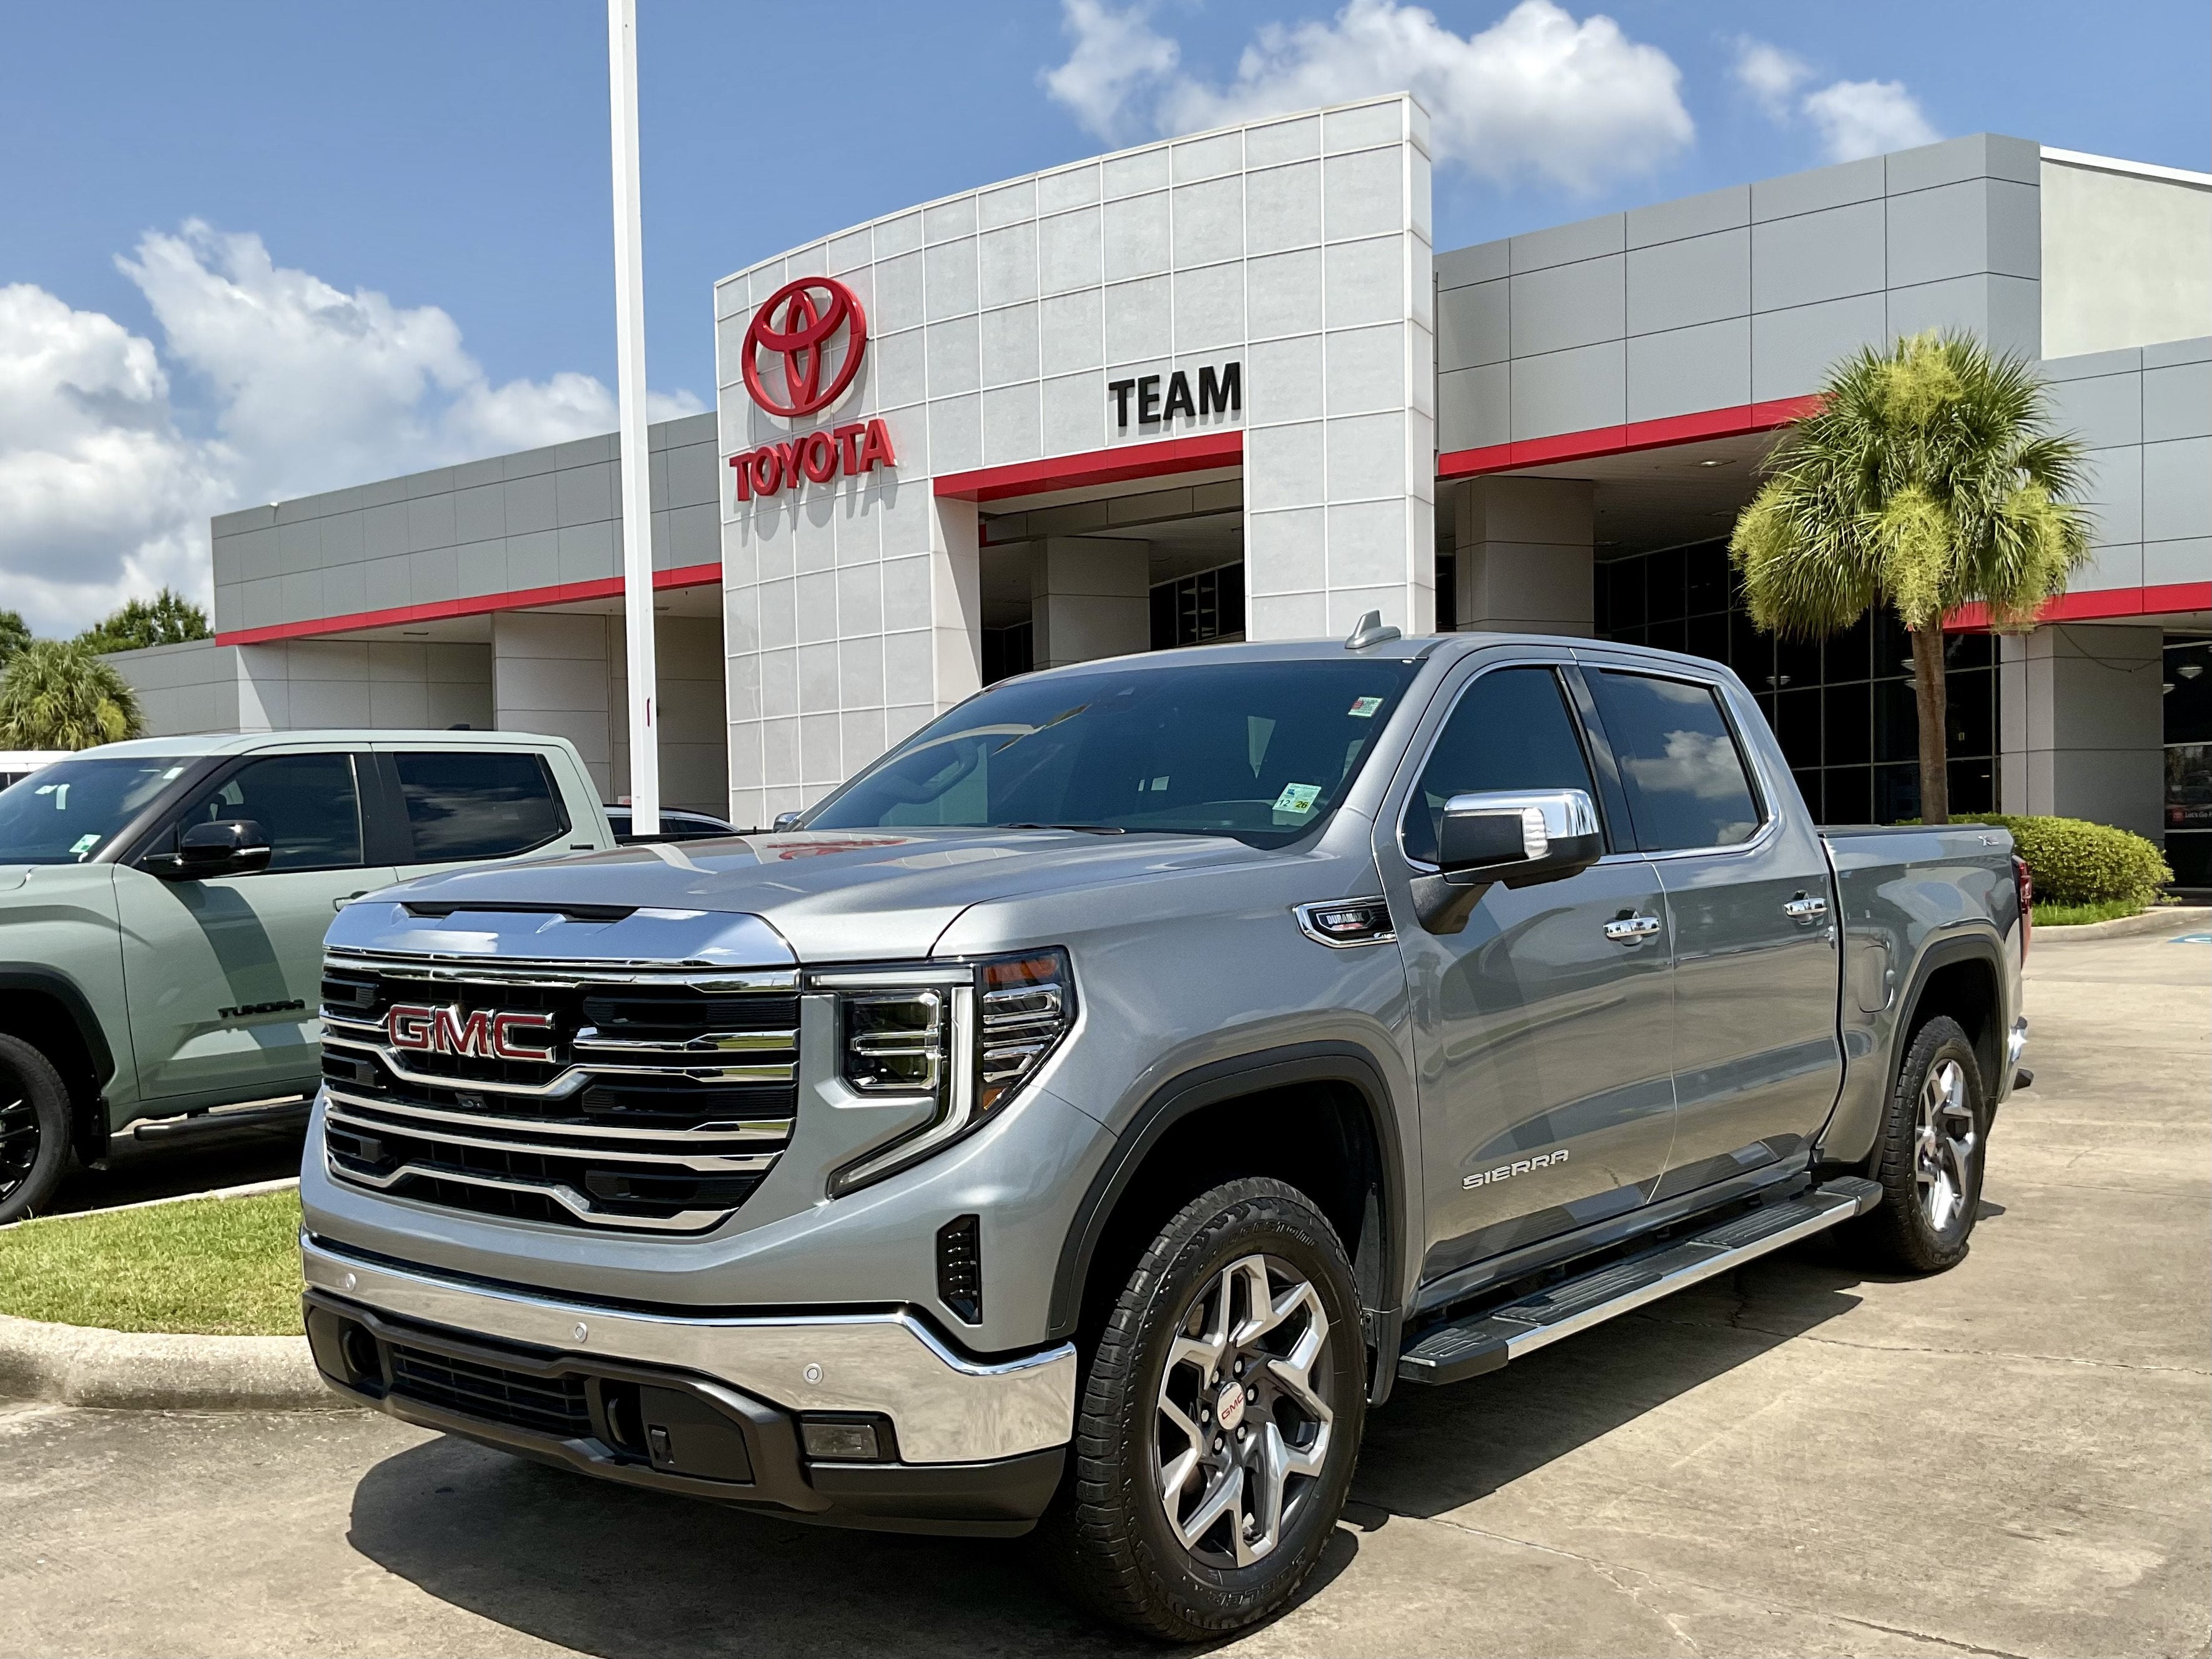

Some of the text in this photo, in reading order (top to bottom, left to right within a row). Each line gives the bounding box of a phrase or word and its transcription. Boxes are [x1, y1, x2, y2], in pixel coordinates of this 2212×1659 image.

[1108, 362, 1241, 426] TEAM
[729, 418, 898, 501] TOYOTA
[1326, 912, 1364, 925] DURAMAX
[218, 999, 305, 1018] TUNDRA
[388, 1003, 557, 1063] GMC
[1462, 1149, 1569, 1190] SIERRA
[1221, 1392, 1244, 1420] GMC
